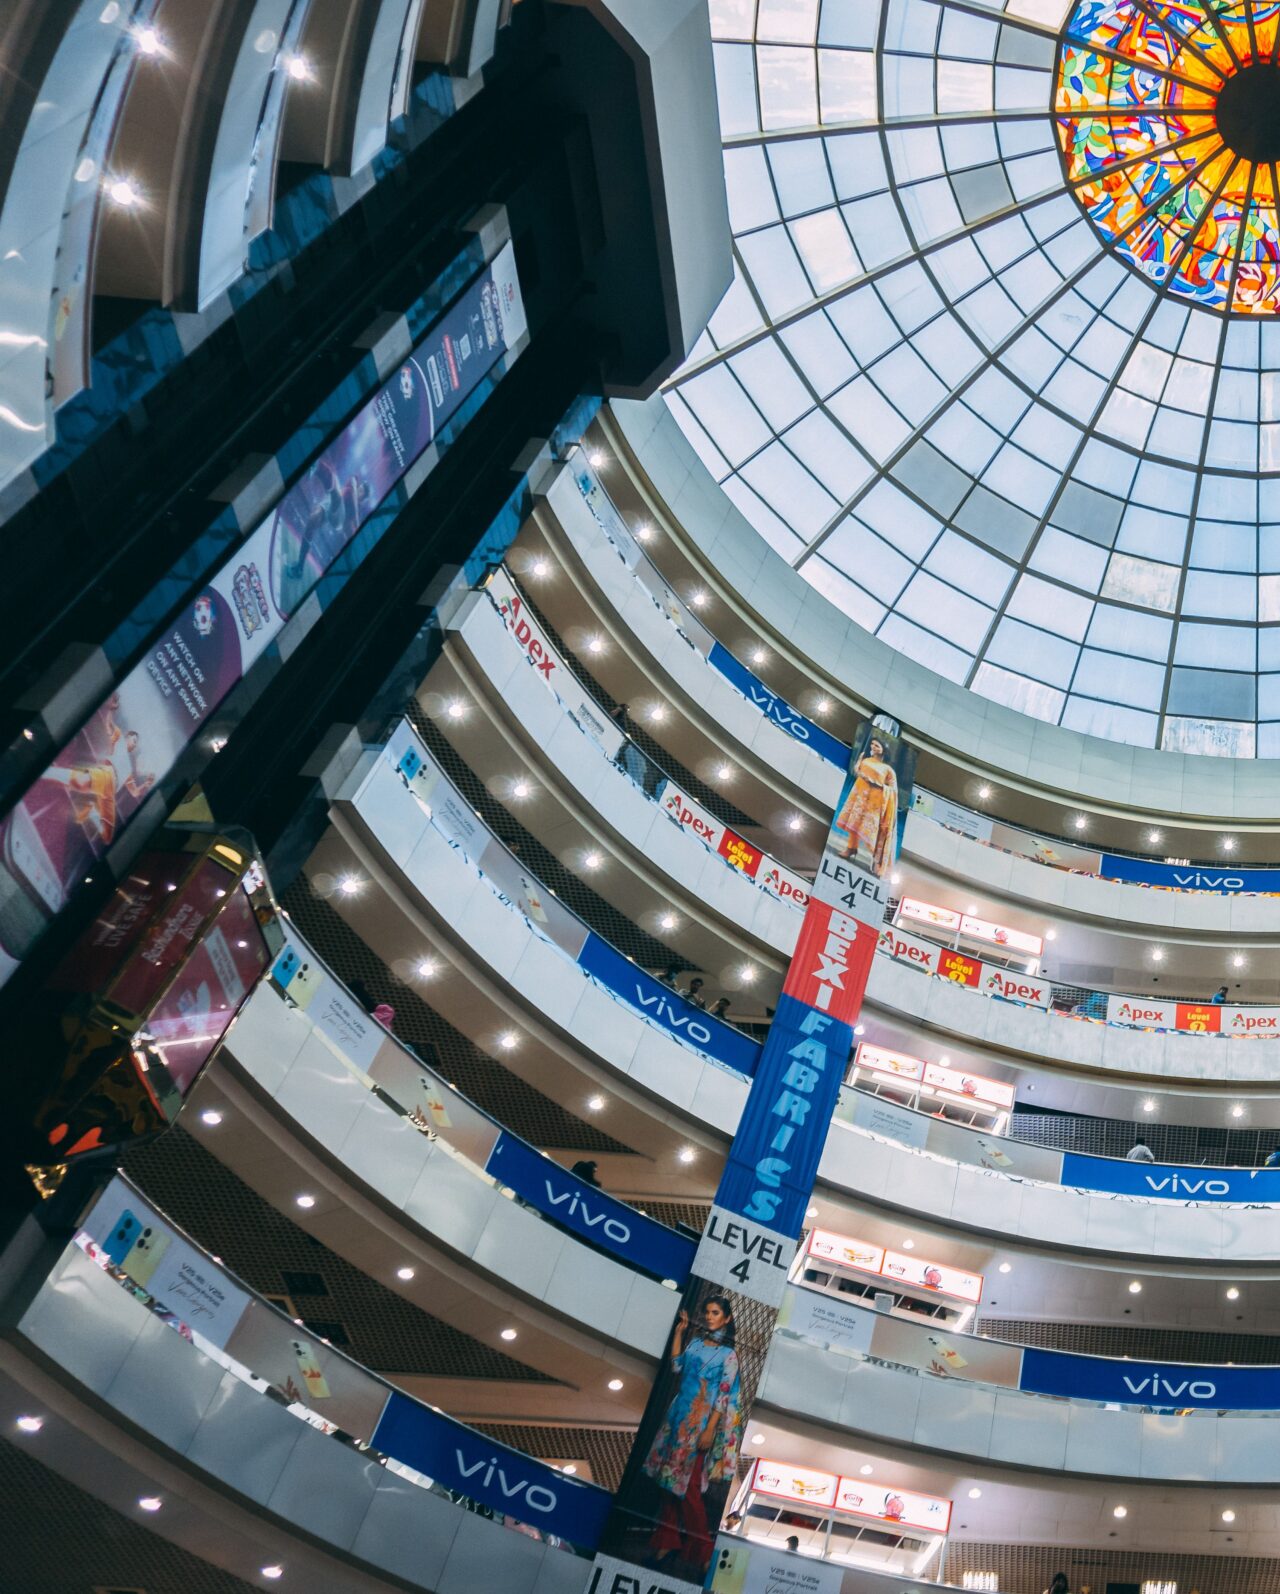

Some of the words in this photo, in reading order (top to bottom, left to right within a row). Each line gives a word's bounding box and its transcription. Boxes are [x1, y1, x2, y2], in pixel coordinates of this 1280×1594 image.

[500, 596, 556, 680] Apex
[173, 632, 195, 668] WATCH
[194, 667, 205, 683] ON
[148, 661, 172, 697] DEVICE
[156, 651, 168, 668] ON
[166, 670, 181, 688] ANY
[179, 688, 200, 720] SMART
[164, 643, 180, 662] ANY
[177, 663, 208, 711] NETWORK
[750, 685, 809, 739] vivo
[667, 795, 715, 842] Apex
[727, 840, 752, 864] Level
[821, 863, 885, 906] LEVEL
[1173, 873, 1244, 888] vivo
[840, 892, 857, 910] 4
[106, 922, 133, 948] LIVE
[879, 930, 932, 966] Apex
[811, 909, 857, 1011] BEXI
[945, 958, 973, 976] Level
[987, 971, 1042, 1001] Apex
[637, 984, 710, 1043] vivo
[1117, 1003, 1163, 1021] Apex
[1187, 1012, 1210, 1021] Level
[1230, 1013, 1277, 1030] Apex
[742, 1010, 834, 1222] FABRICS
[1145, 1174, 1230, 1195] vivo
[545, 1180, 630, 1243] vivo
[707, 1216, 787, 1271] LEVEL
[729, 1258, 750, 1283] 4
[1123, 1373, 1217, 1399] vivo
[456, 1449, 557, 1512] vivo
[770, 1567, 785, 1575] V25
[801, 1575, 820, 1584] V25e
